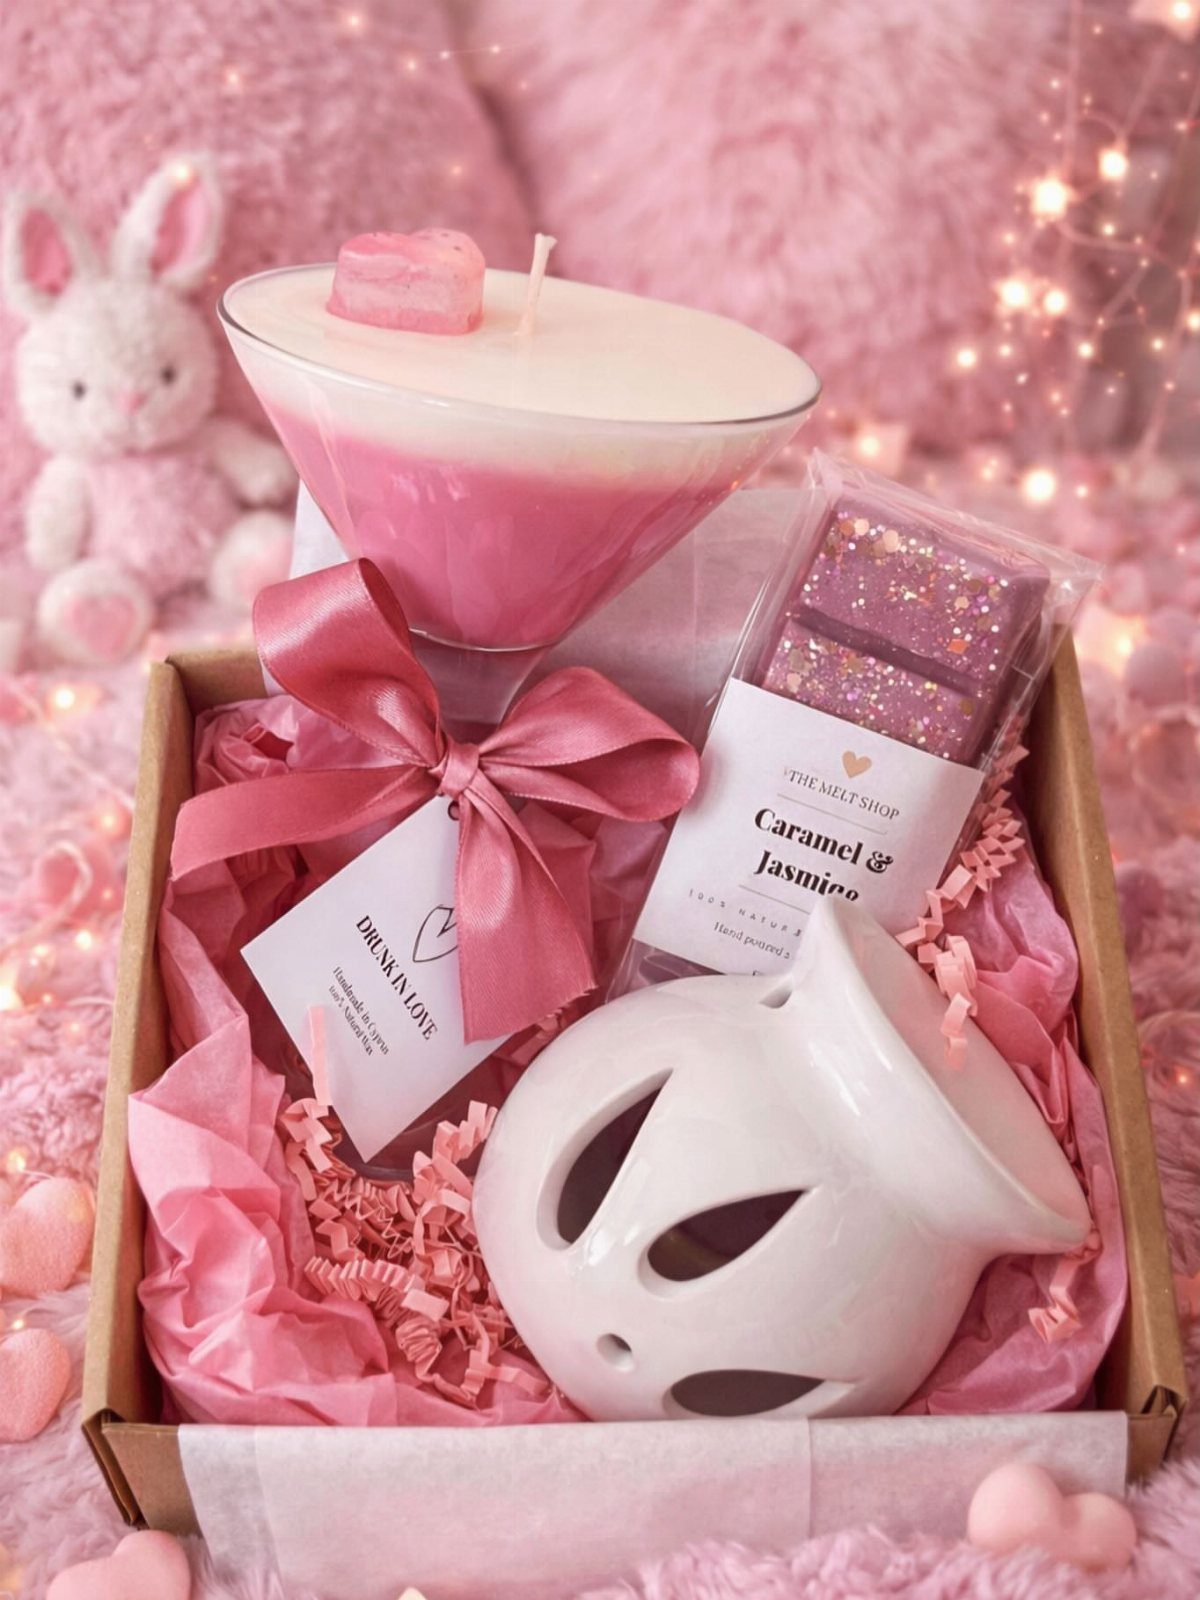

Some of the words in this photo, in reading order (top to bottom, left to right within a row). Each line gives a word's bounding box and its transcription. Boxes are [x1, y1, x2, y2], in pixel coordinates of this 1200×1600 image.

[789, 769, 818, 790] THE
[819, 781, 858, 805] MELT
[859, 796, 900, 820] SHOP
[754, 808, 864, 865] Caramel
[865, 851, 894, 874] &
[714, 922, 744, 940] Hand
[743, 936, 784, 956] poured
[356, 915, 399, 978] DRUNK
[391, 973, 412, 995] IN
[404, 992, 438, 1040] LOVE
